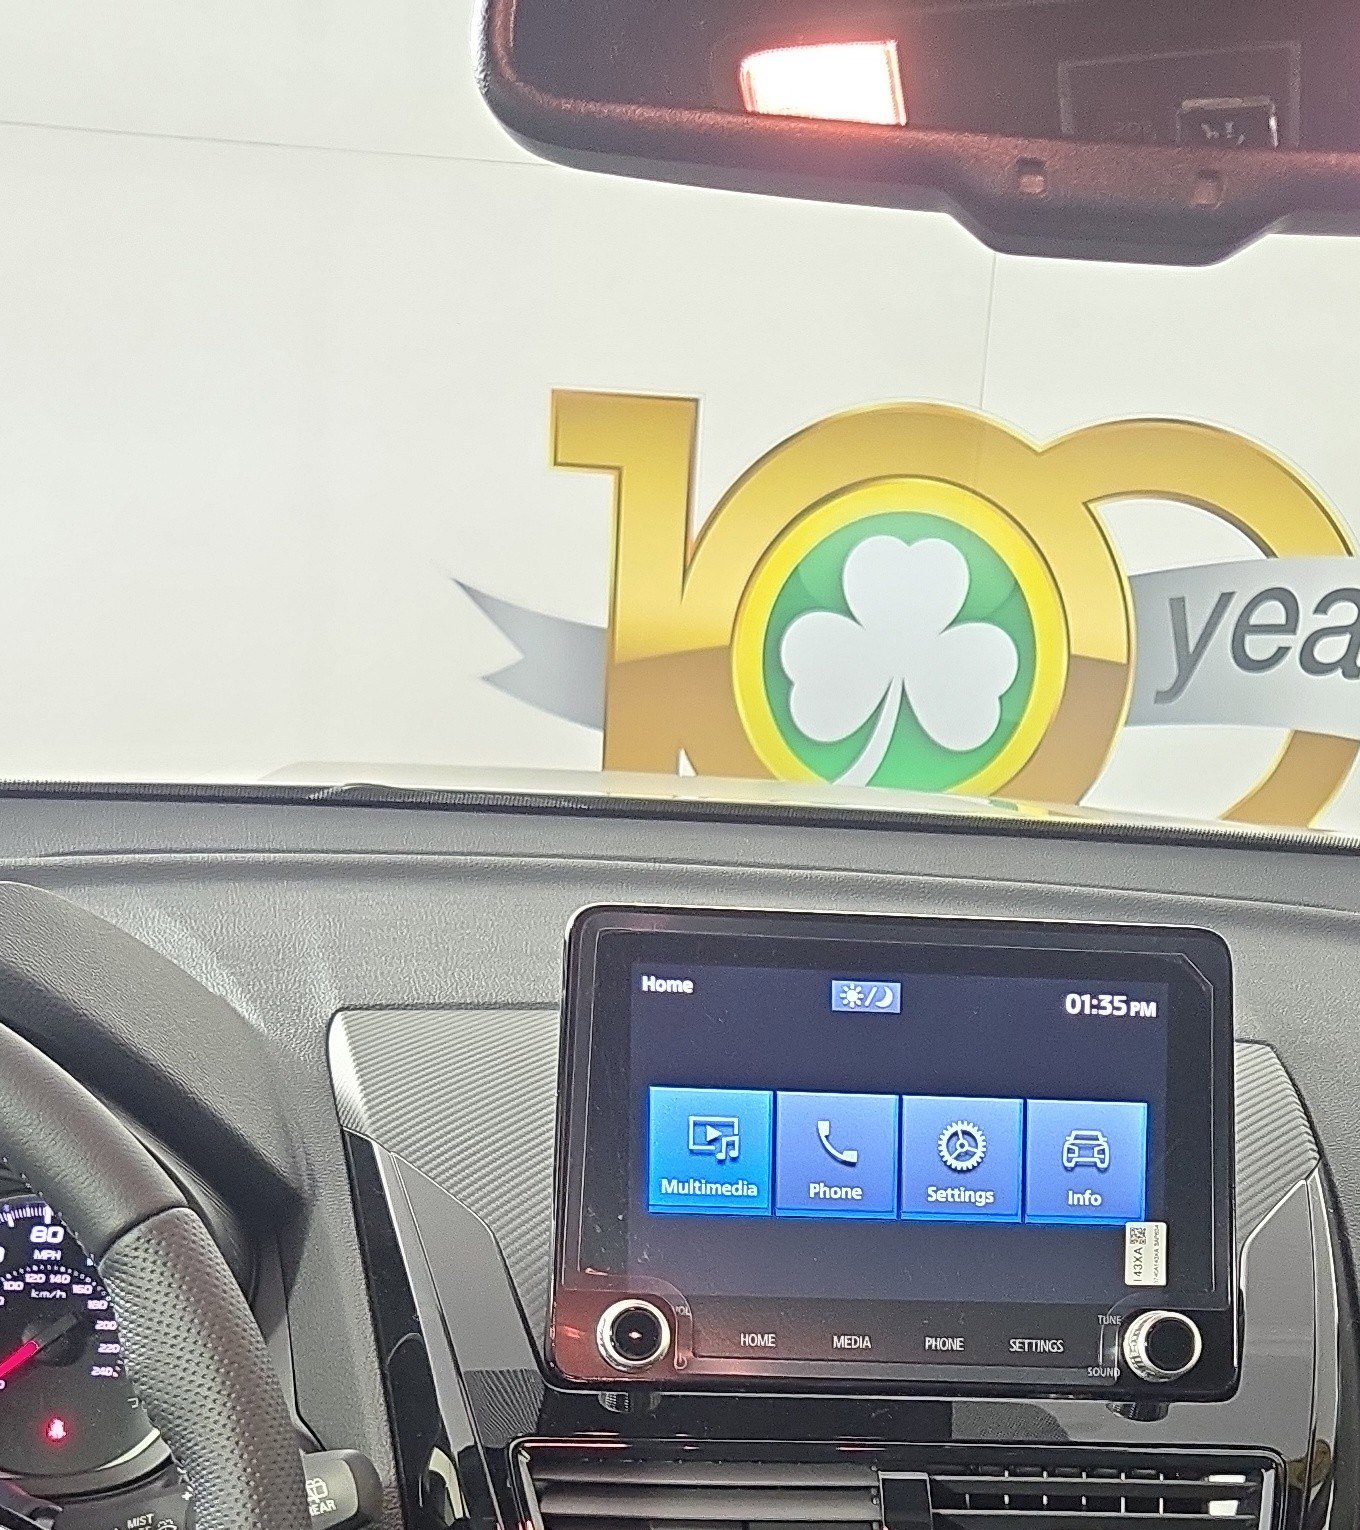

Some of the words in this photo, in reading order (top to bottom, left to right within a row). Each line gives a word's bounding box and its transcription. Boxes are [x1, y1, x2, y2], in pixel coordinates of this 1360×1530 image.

[642, 975, 694, 994] Home
[1065, 993, 1127, 1016] 01:35
[1130, 1001, 1157, 1017] PM
[661, 1178, 758, 1197] Multimedia
[809, 1182, 863, 1200] Phone
[927, 1186, 994, 1206] Settings
[1068, 1190, 1102, 1206] Info
[30, 1226, 64, 1243] 80
[33, 1249, 61, 1260] MPH
[25, 1274, 46, 1283] 120
[49, 1274, 70, 1284] 140
[3, 1281, 24, 1291] 100
[31, 1290, 66, 1299] km/h
[95, 1321, 117, 1330] 200
[1097, 1314, 1122, 1326] TUNE
[740, 1333, 776, 1348] HOME
[832, 1335, 872, 1349] MEDIA
[925, 1336, 964, 1351] PHONE
[1009, 1338, 1064, 1352] SETTINGS
[98, 1344, 120, 1353] 220
[90, 1366, 113, 1376] 240
[1087, 1366, 1121, 1378] SOUND
[127, 1514, 154, 1529] MIST
